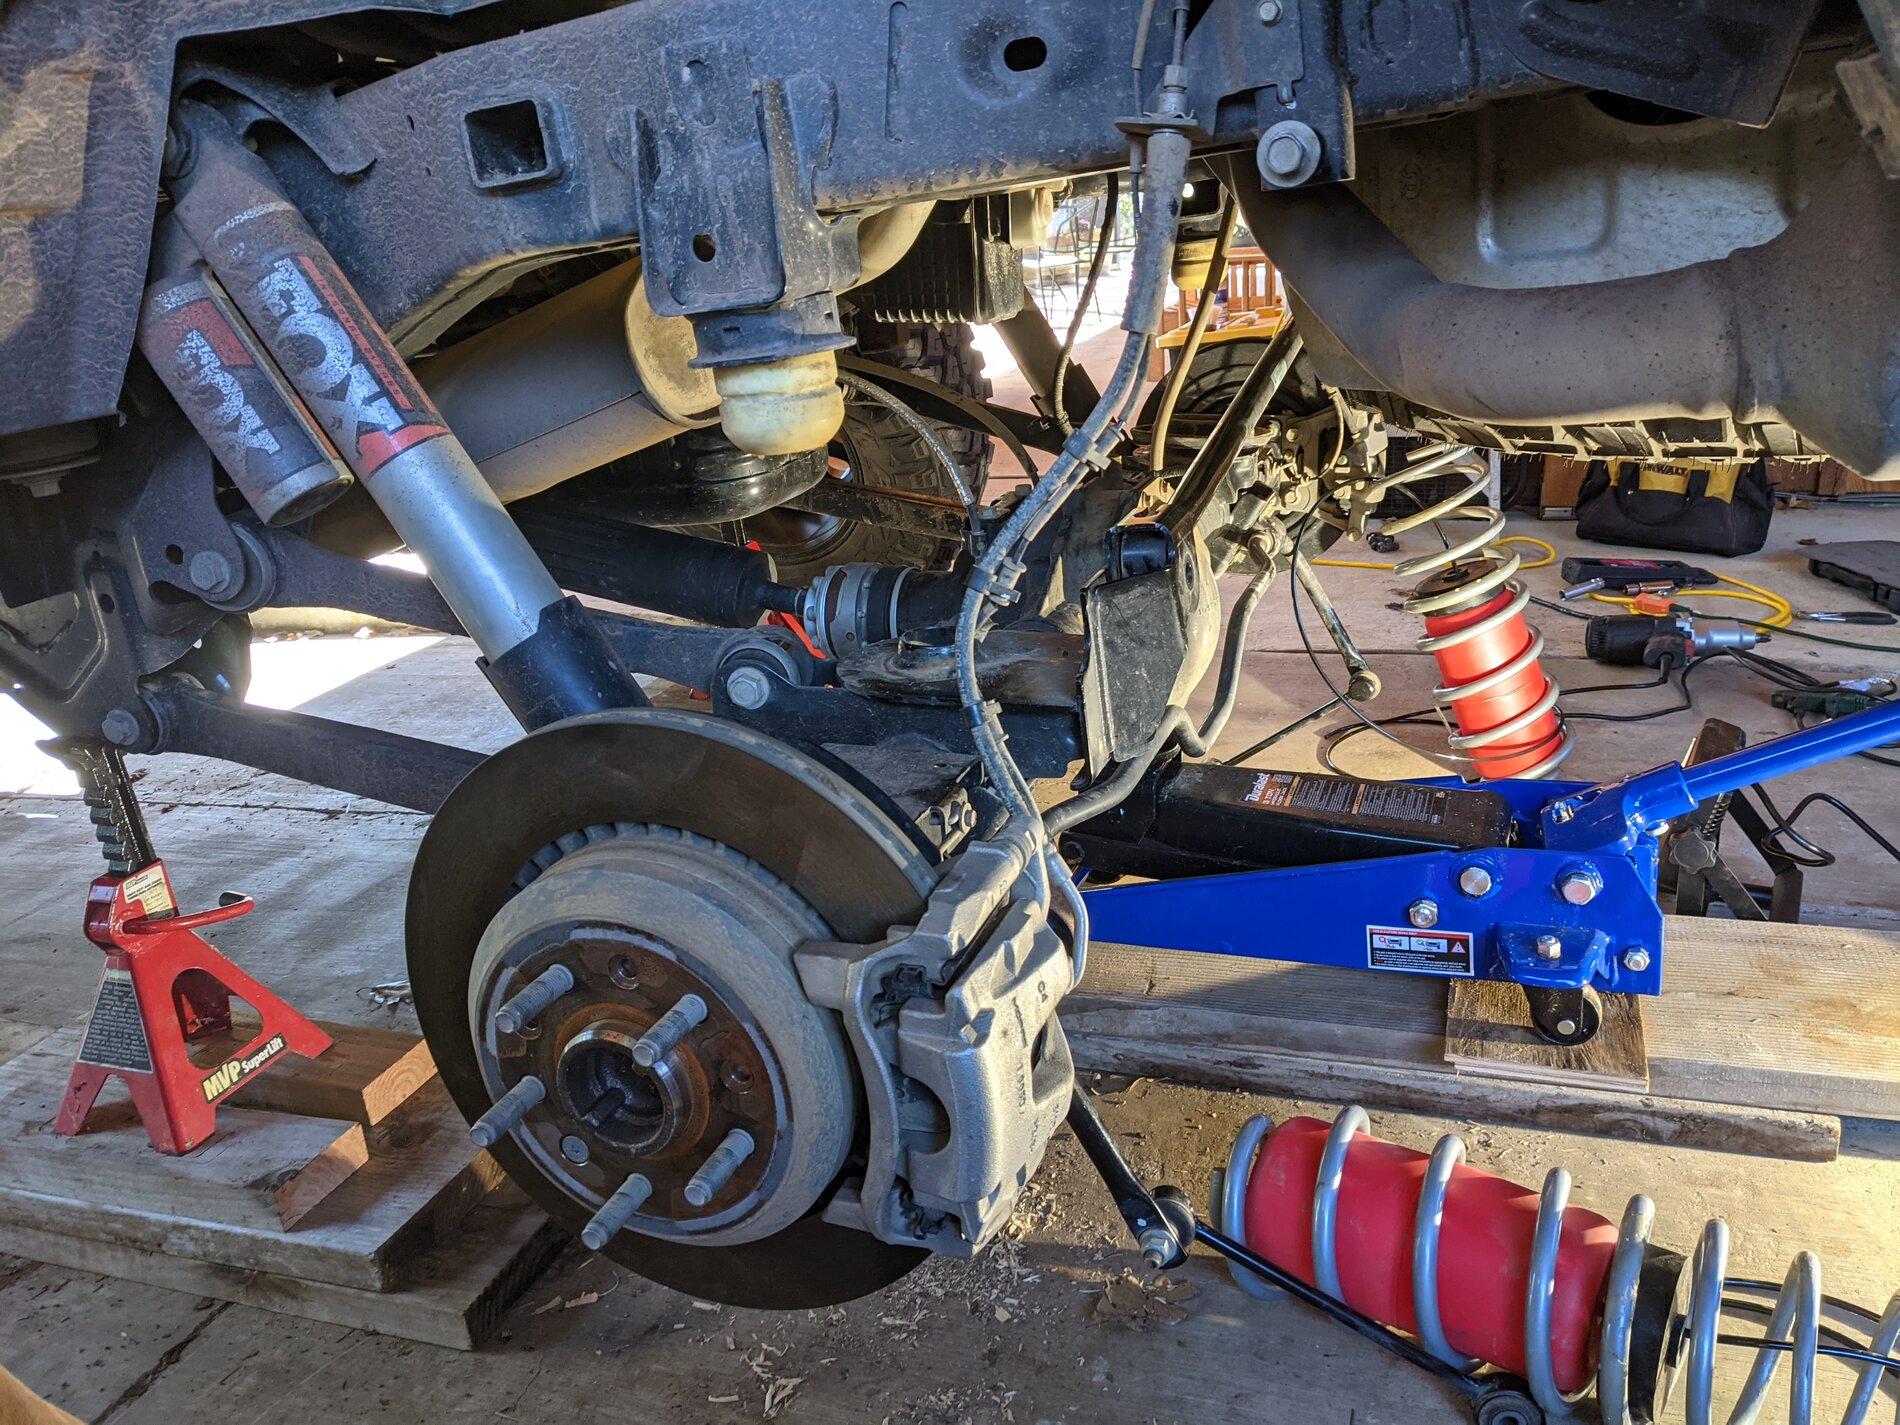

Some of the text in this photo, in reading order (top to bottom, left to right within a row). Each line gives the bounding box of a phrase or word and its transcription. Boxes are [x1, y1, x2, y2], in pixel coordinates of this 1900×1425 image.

[257, 257, 404, 457] FOX
[315, 275, 403, 400] INTERNAL BYPASS
[176, 328, 281, 455] FOX
[1640, 462, 1688, 475] WALT
[1244, 772, 1270, 802] Duralast
[202, 1036, 284, 1102] MVP SuperLift
